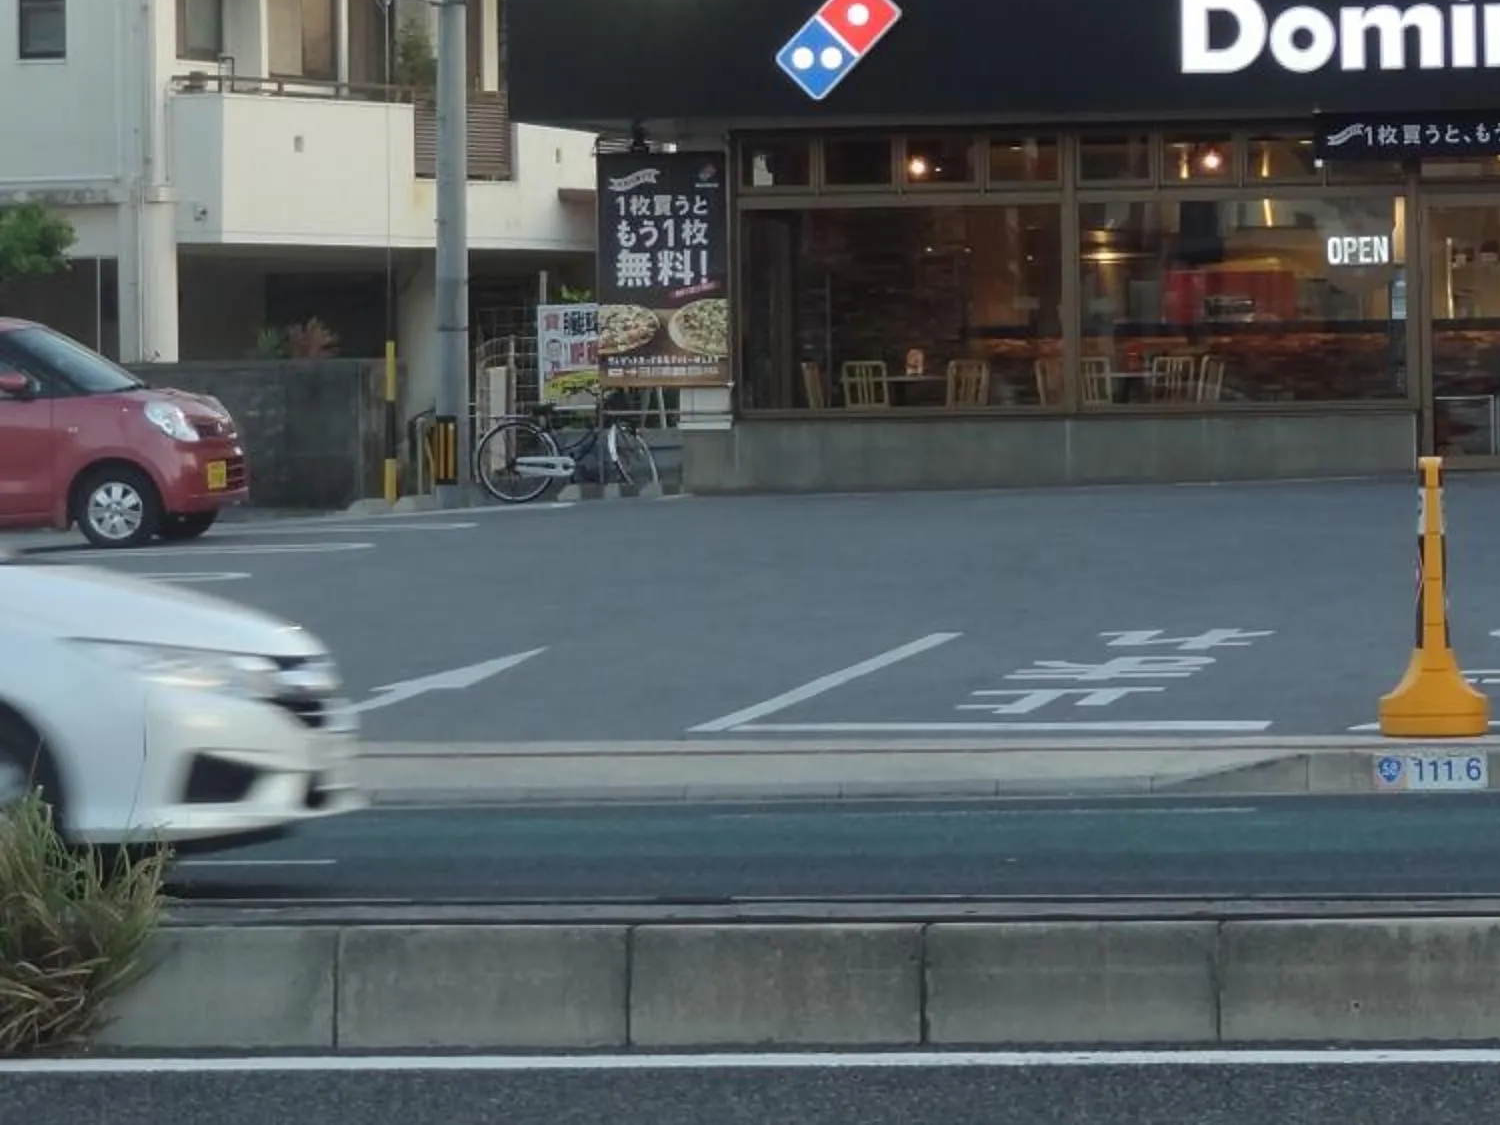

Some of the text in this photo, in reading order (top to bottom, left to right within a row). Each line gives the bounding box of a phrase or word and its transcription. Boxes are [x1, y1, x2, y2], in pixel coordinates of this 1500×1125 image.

[615, 194, 708, 217] 1枚買うと
[616, 218, 709, 248] もう1枚
[1327, 235, 1390, 267] OPEN
[616, 249, 708, 287] 無料!
